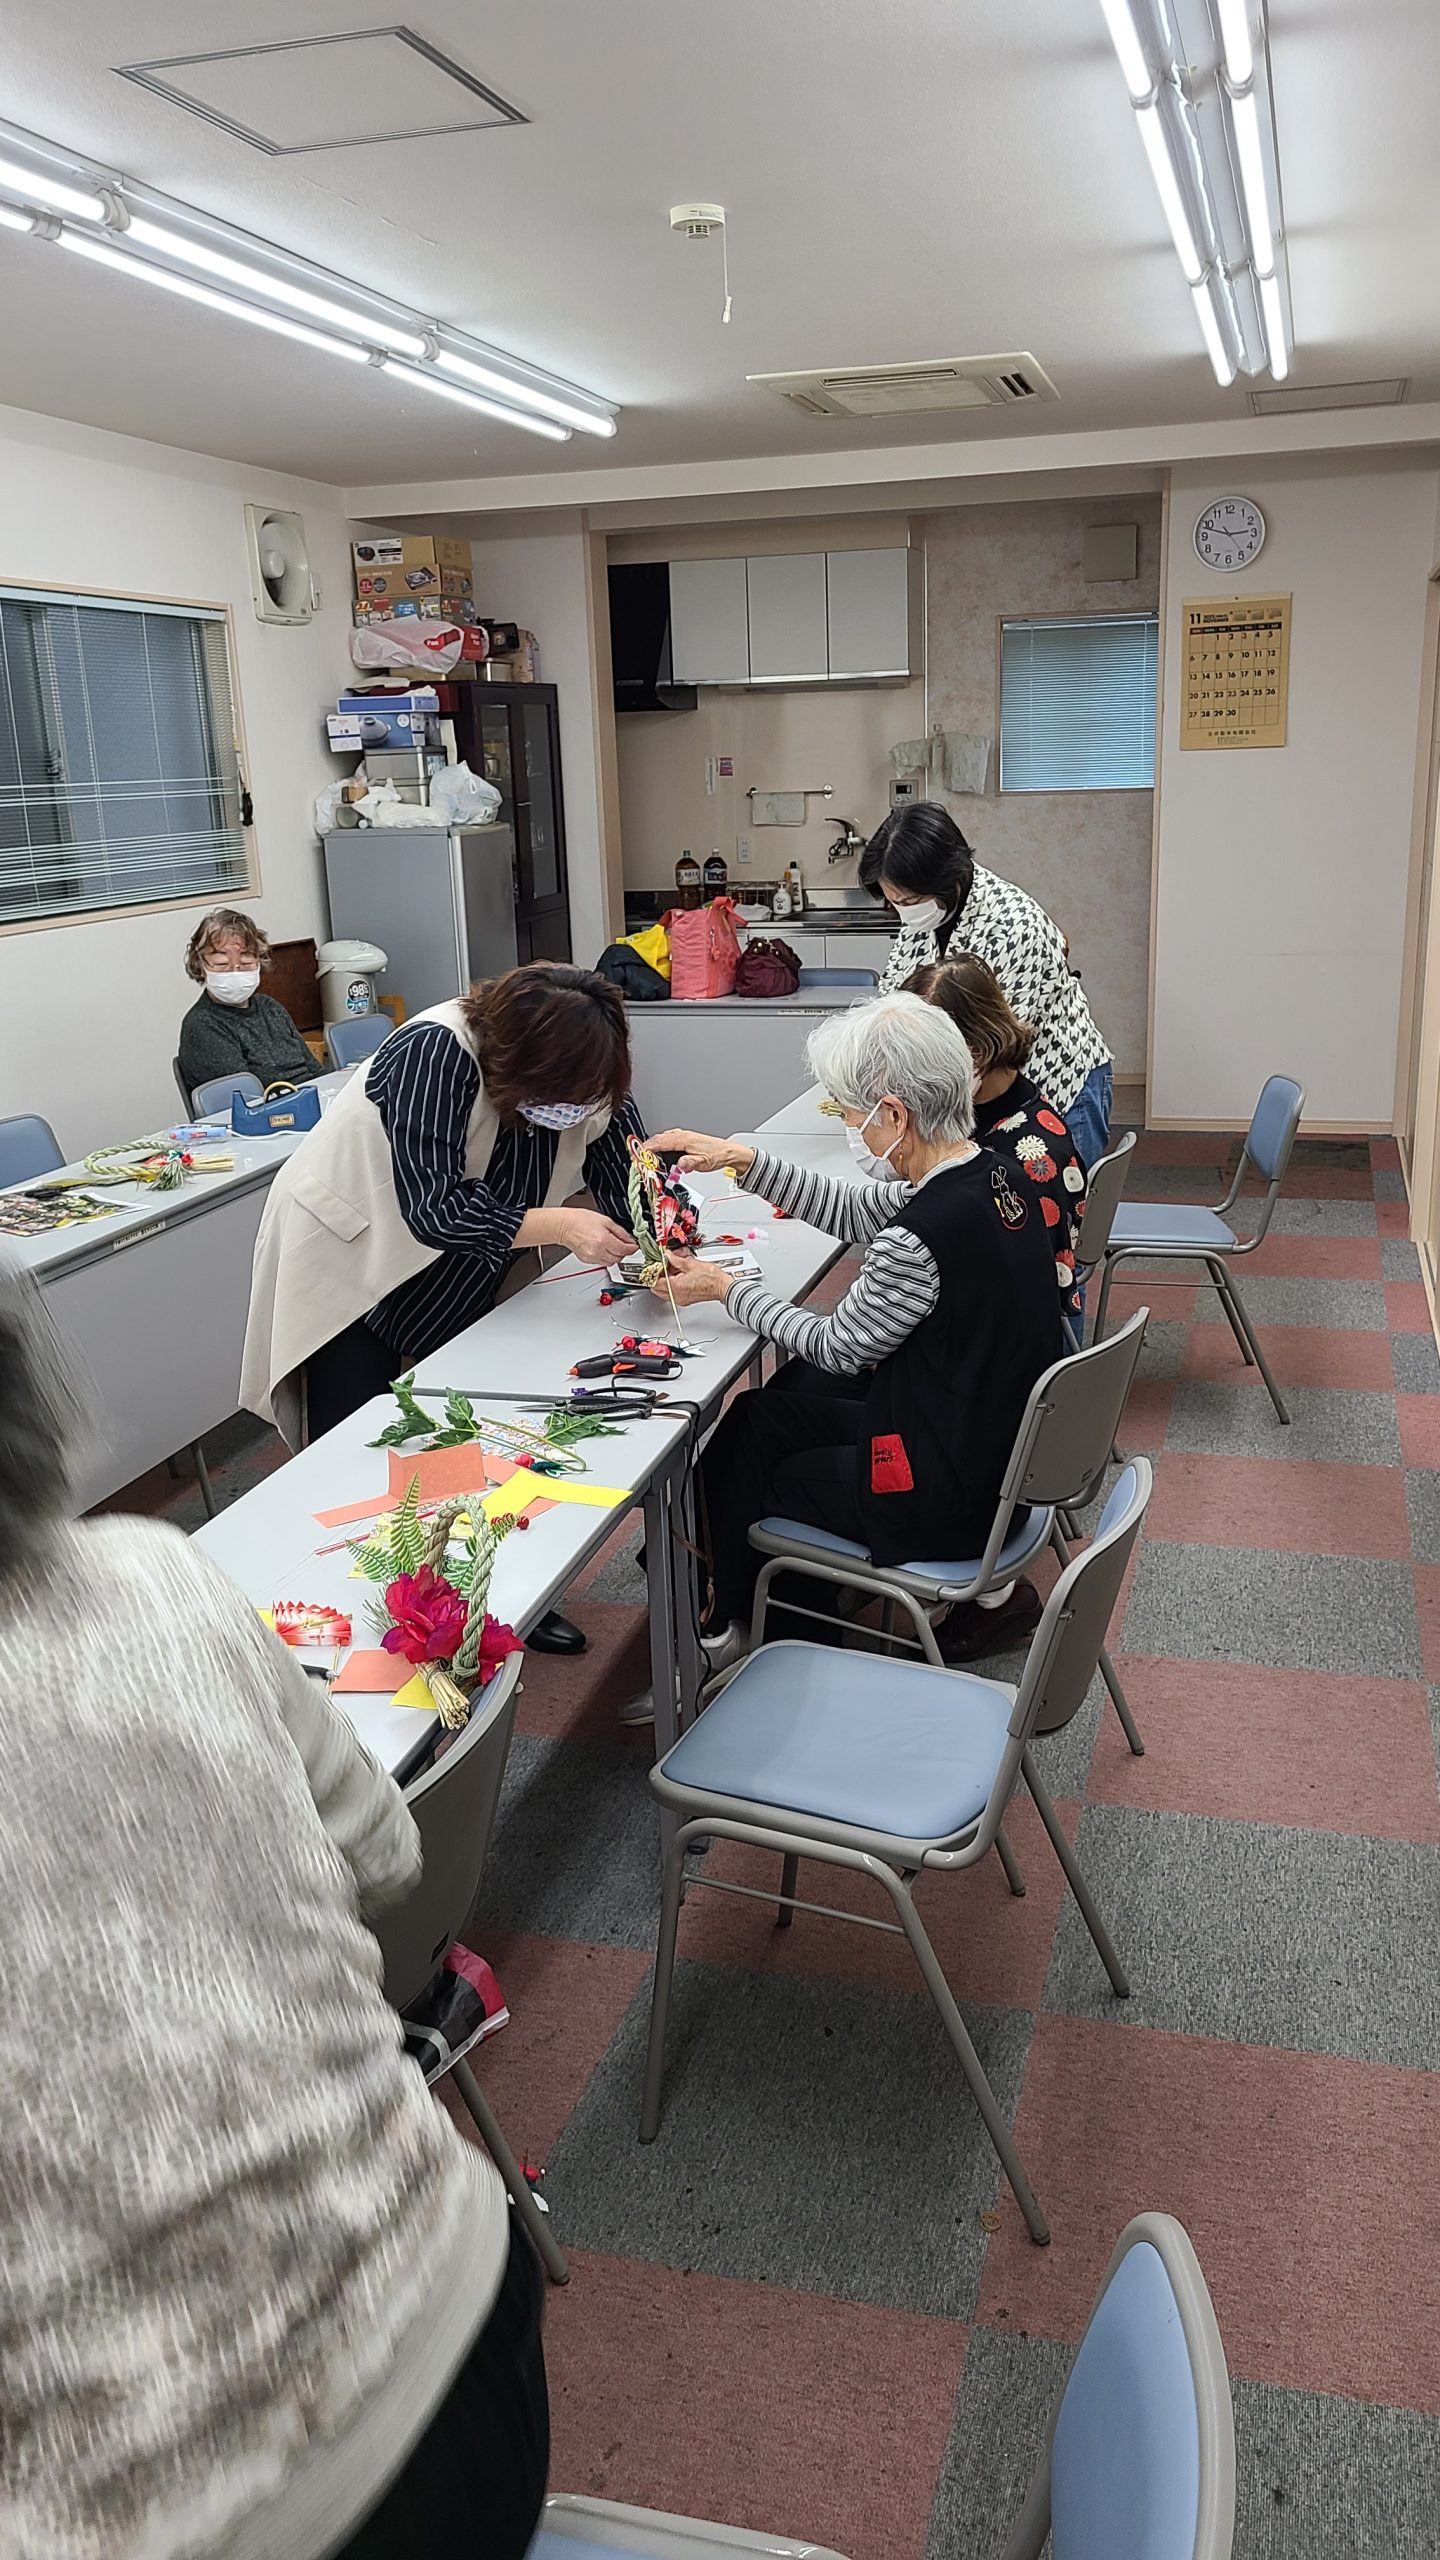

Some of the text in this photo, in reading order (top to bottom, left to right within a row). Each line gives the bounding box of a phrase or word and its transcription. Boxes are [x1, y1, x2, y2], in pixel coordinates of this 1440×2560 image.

[1213, 509, 1221, 518] 11
[1225, 505, 1235, 514] 12
[1204, 519, 1214, 528] 10
[1248, 516, 1254, 525] 2
[1201, 532, 1208, 541] 9
[1251, 528, 1257, 537] 3
[1205, 544, 1211, 553] 8
[1247, 541, 1253, 550] 4
[1214, 553, 1220, 562] 7
[1225, 555, 1231, 564] 6
[1238, 551, 1244, 560] 5
[1190, 614, 1201, 624] 11
